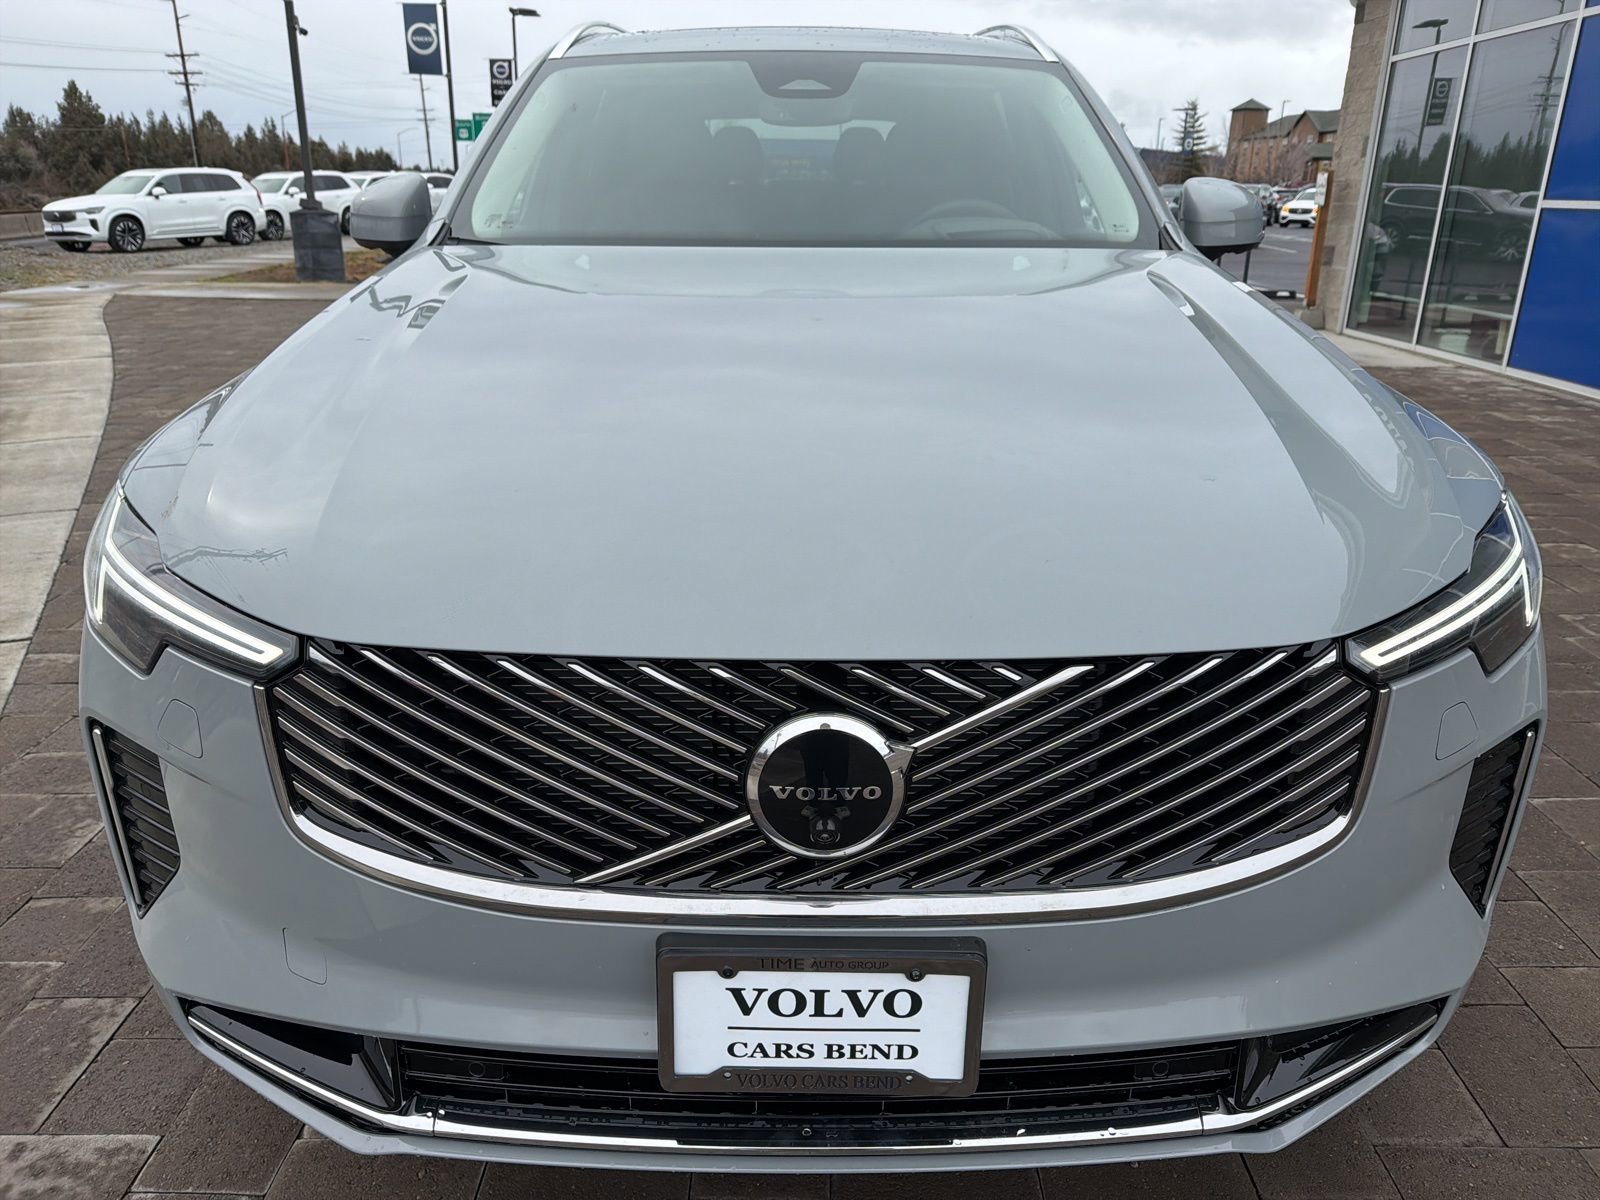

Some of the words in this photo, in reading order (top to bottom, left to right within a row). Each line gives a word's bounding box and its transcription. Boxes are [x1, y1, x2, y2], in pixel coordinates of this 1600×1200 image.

[769, 785, 882, 801] VOLVO
[760, 958, 805, 970] TIME
[810, 960, 845, 969] AUTO
[848, 961, 889, 970] GROUP
[725, 987, 923, 1018] VOLVO
[727, 1042, 815, 1059] CARS
[823, 1043, 919, 1061] BEND
[736, 1073, 798, 1089] VOLVO
[801, 1074, 849, 1089] CARS
[853, 1075, 902, 1090] BEND
